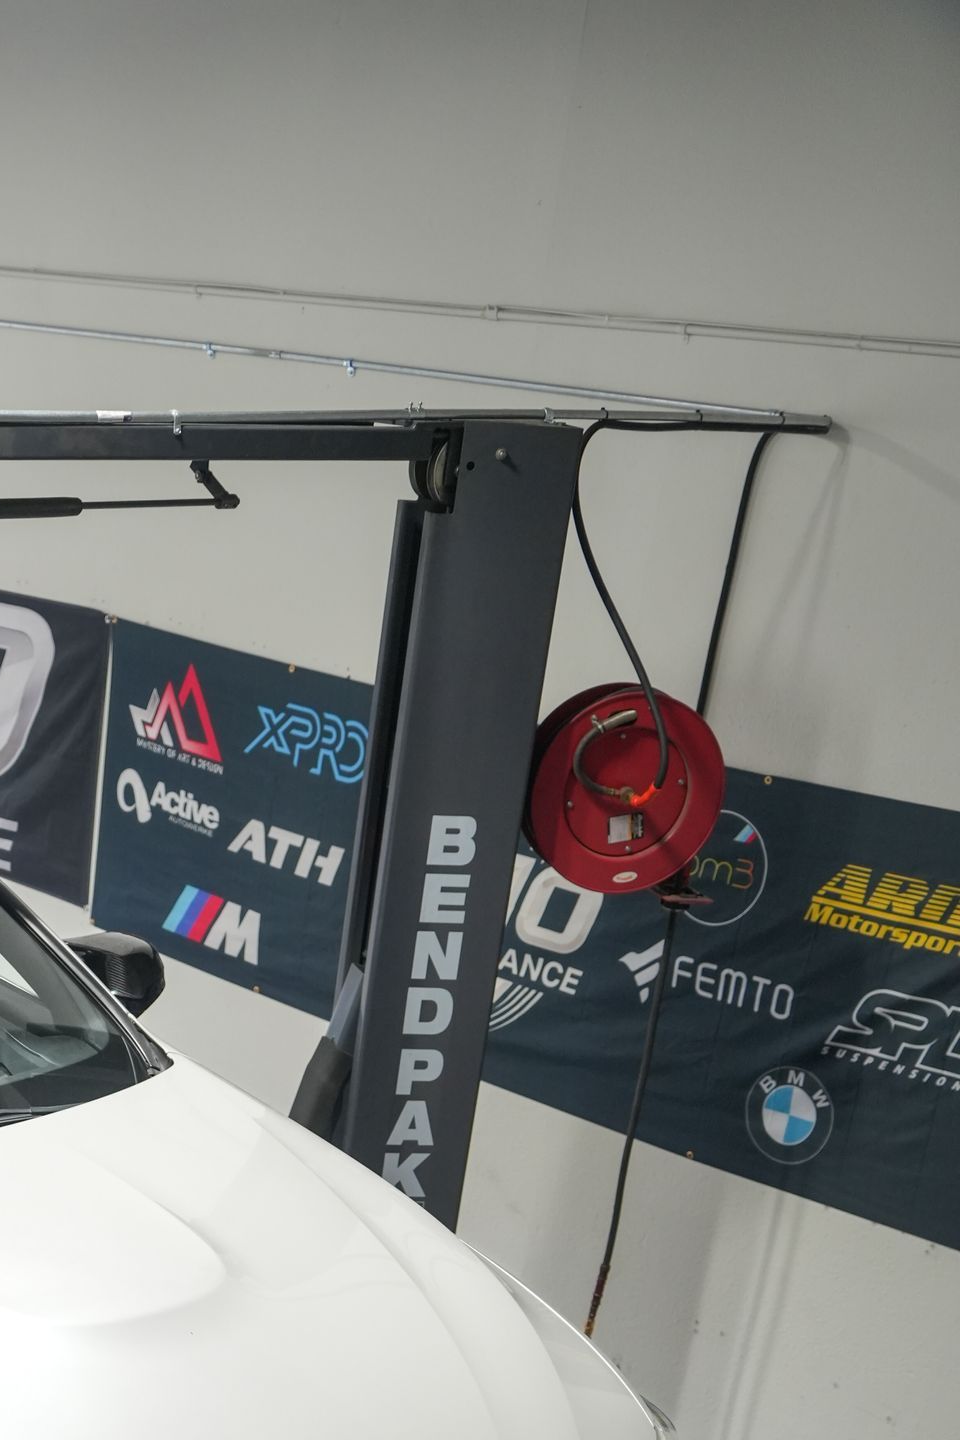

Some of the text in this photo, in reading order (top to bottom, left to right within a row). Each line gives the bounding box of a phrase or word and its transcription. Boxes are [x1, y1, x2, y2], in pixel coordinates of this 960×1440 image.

[150, 780, 220, 830] Active
[227, 818, 345, 886] ATH
[803, 902, 960, 958] Motorspor
[380, 815, 477, 1198] BENDPAK
[671, 955, 794, 1020] FEMTO
[758, 1069, 830, 1110] BMW
